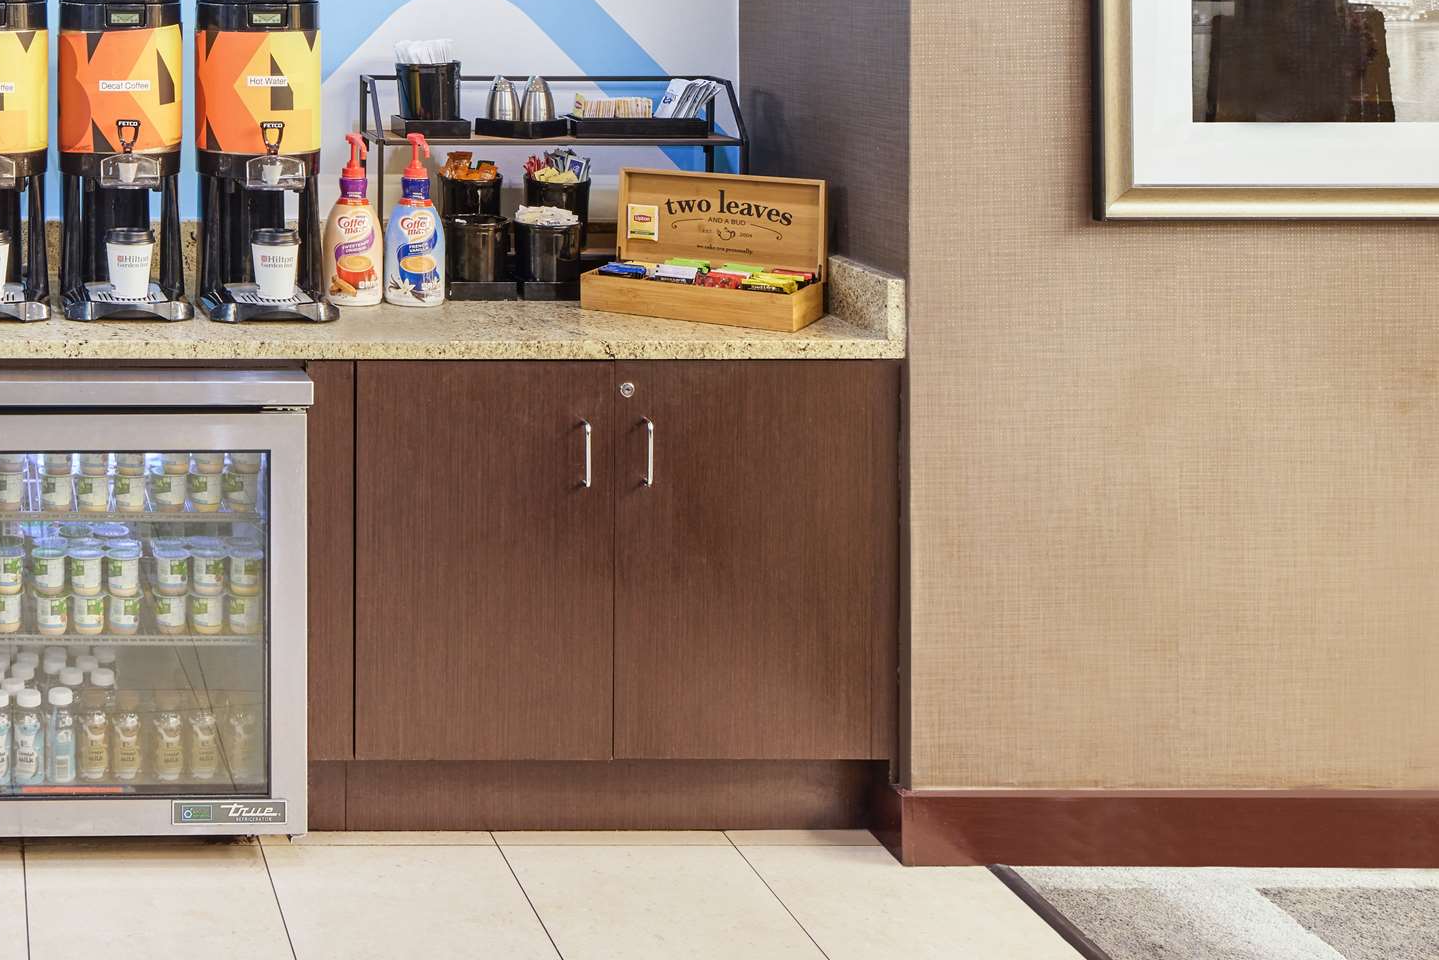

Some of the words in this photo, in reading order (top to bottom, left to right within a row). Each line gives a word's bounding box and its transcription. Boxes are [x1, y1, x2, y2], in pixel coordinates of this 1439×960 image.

[101, 82, 122, 90] Decaf
[124, 82, 150, 90] Coffee
[249, 76, 264, 86] Hot
[265, 76, 287, 85] Water
[664, 198, 711, 215] two
[718, 190, 793, 226] leaves
